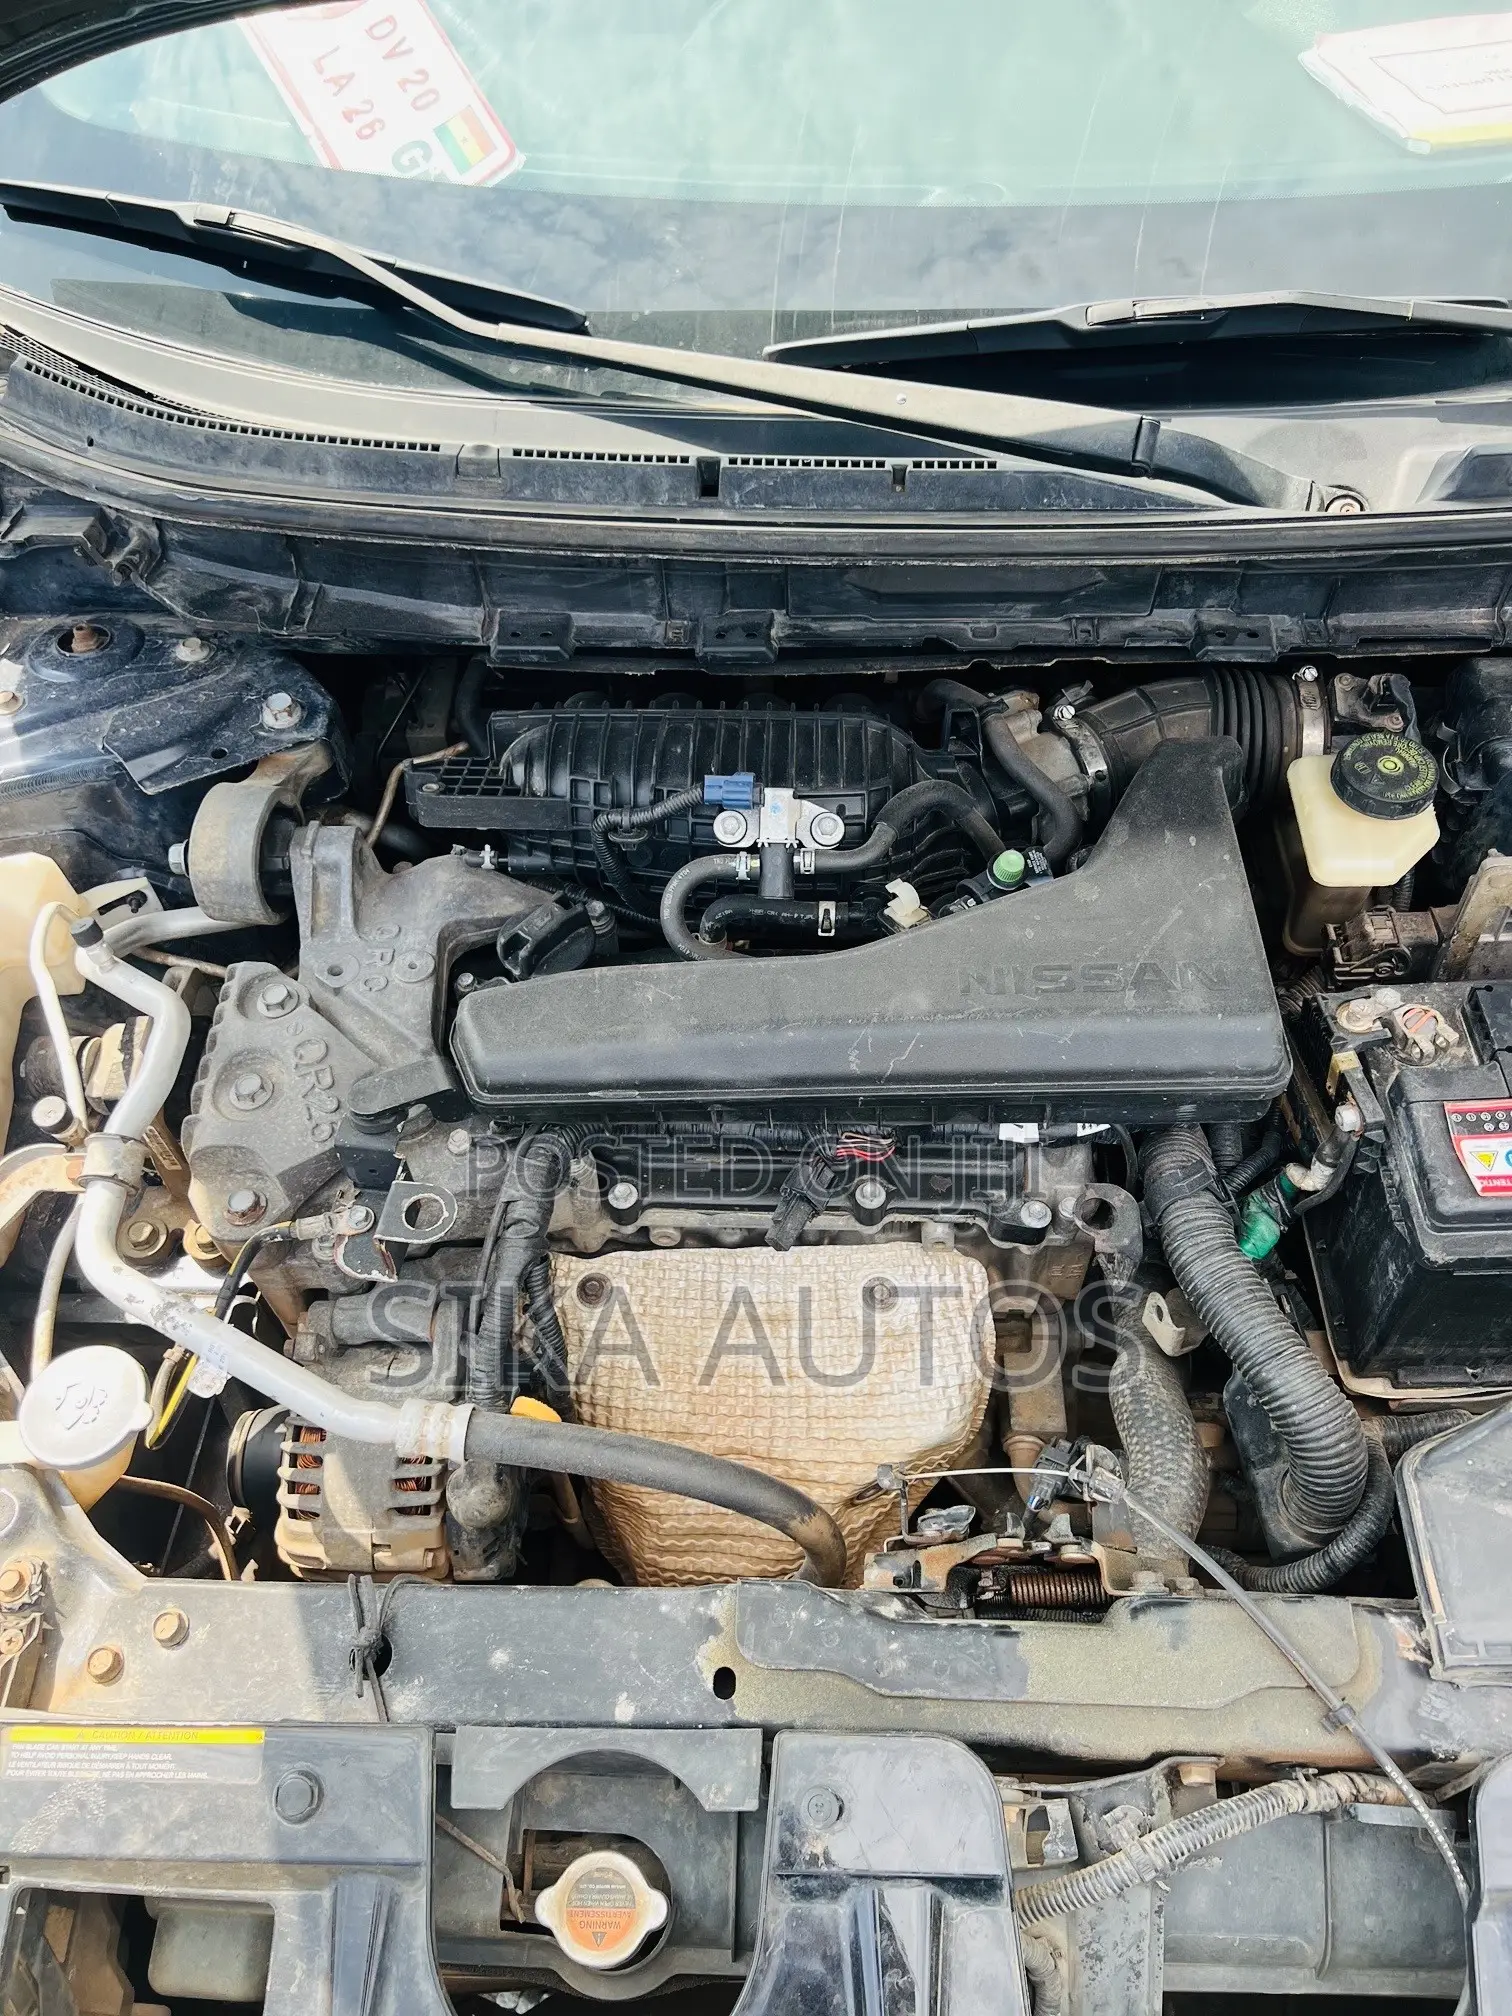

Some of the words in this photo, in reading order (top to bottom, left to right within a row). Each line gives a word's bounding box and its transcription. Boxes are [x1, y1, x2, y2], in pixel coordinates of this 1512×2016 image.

[364, 14, 414, 60] DV
[397, 68, 440, 111] 20
[312, 45, 356, 97] LA
[342, 98, 386, 140] 26
[391, 139, 447, 180] G
[958, 961, 1230, 995] NISSAN
[293, 1036, 340, 1143] QR25
[92, 1730, 136, 1740] CAUTION
[145, 1731, 199, 1740] ATTENTION
[568, 1910, 632, 1919] AVERTISSEMENT
[579, 1920, 620, 1930] WARNING
